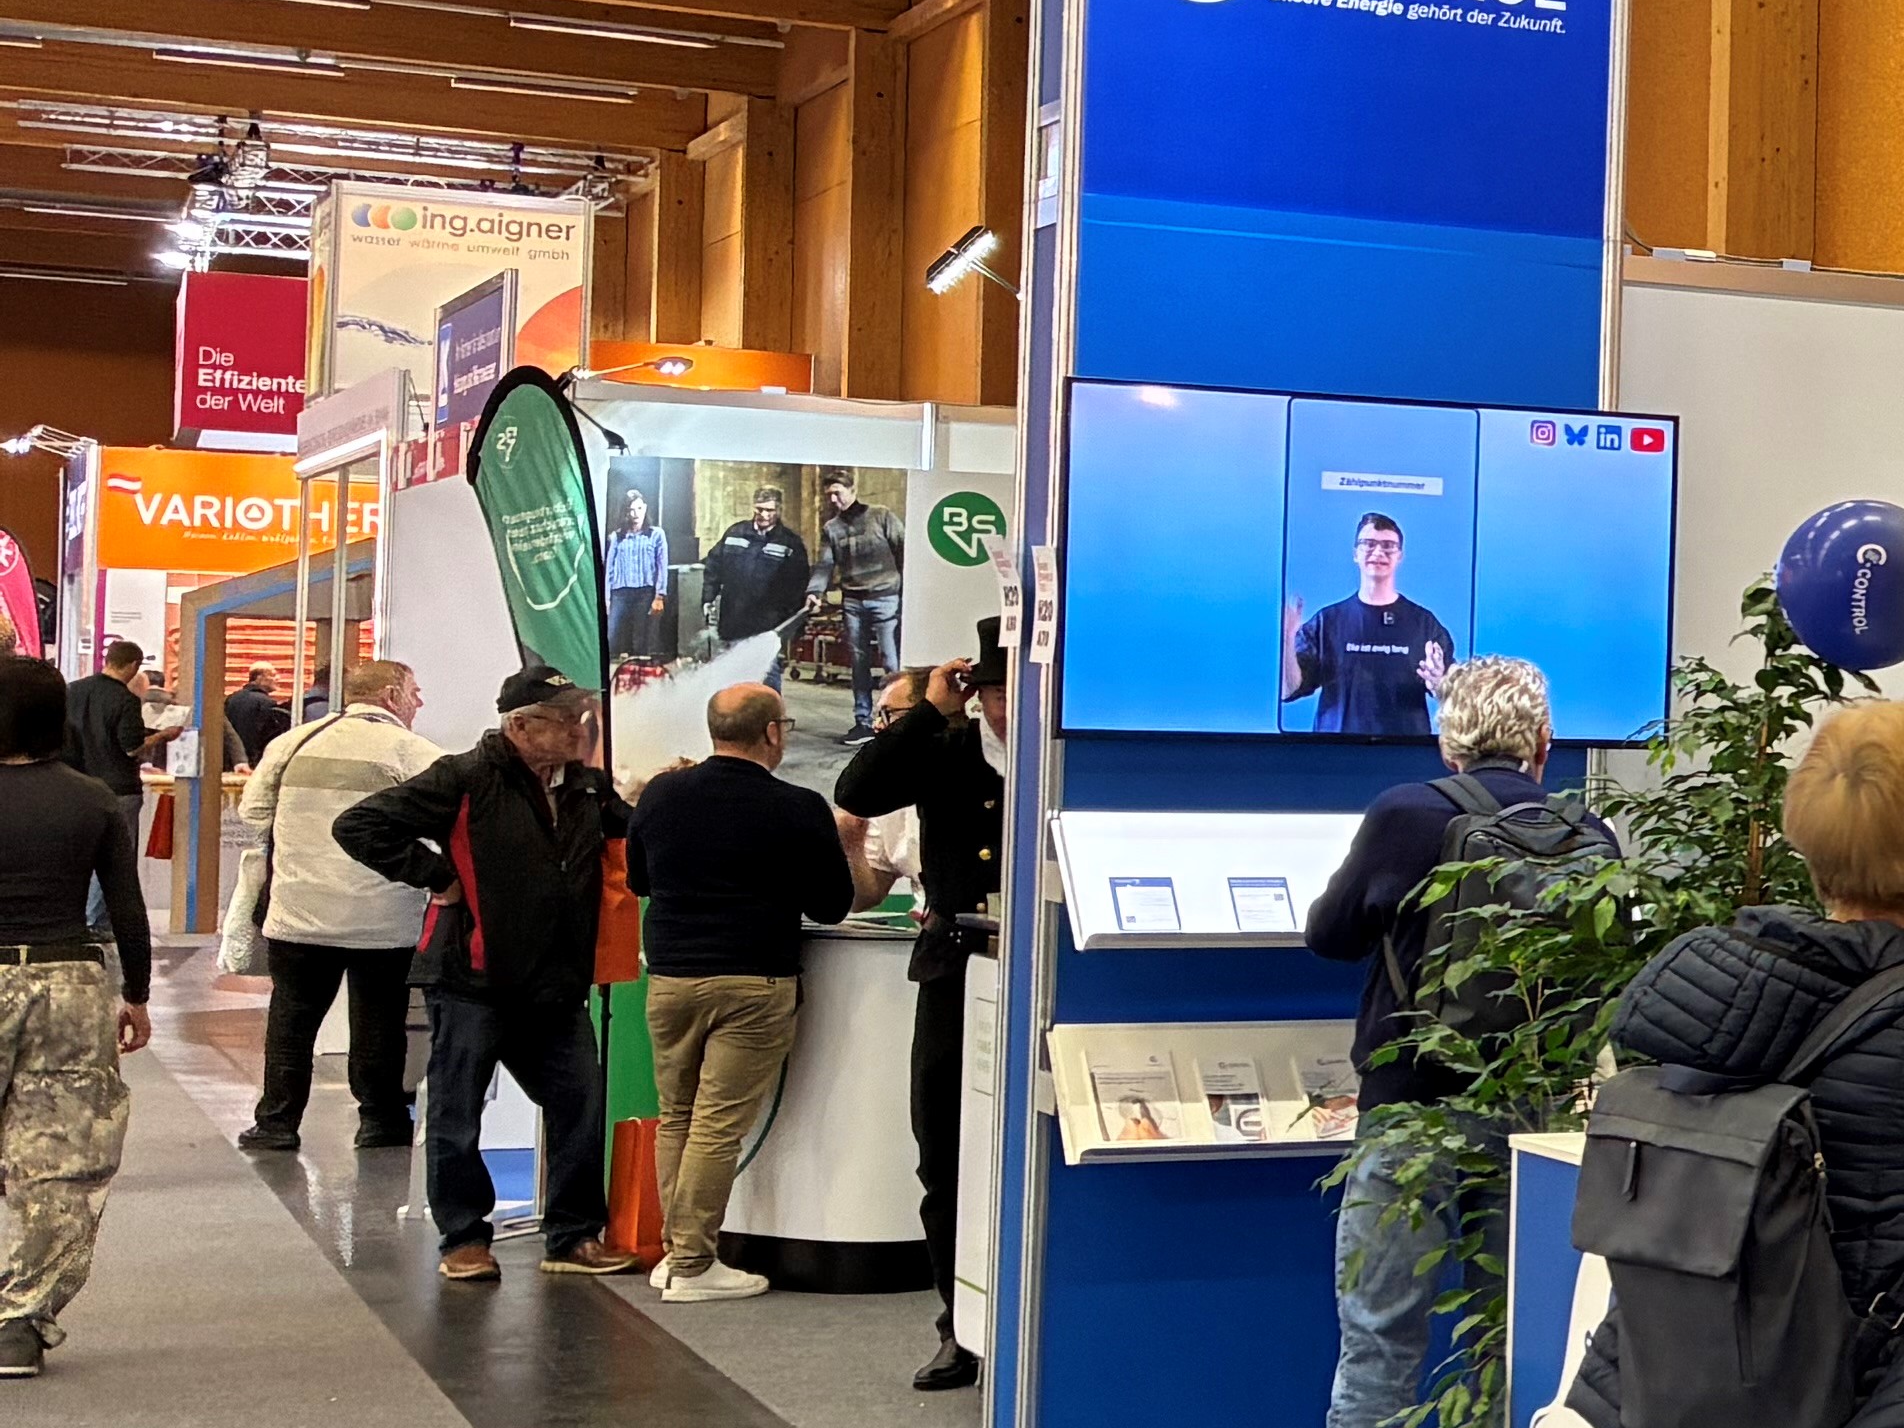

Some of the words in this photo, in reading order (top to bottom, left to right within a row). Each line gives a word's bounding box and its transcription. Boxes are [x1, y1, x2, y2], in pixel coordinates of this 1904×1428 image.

[1407, 3, 1463, 22] gehört
[1466, 9, 1496, 25] der
[1498, 12, 1566, 33] Zukunft.
[422, 206, 576, 242] ing.aigner
[351, 235, 401, 246] wasser
[467, 245, 520, 256] umwelt
[527, 249, 569, 260] gmbh
[199, 346, 234, 366] Die
[196, 391, 233, 410] der
[238, 393, 285, 414] Welt
